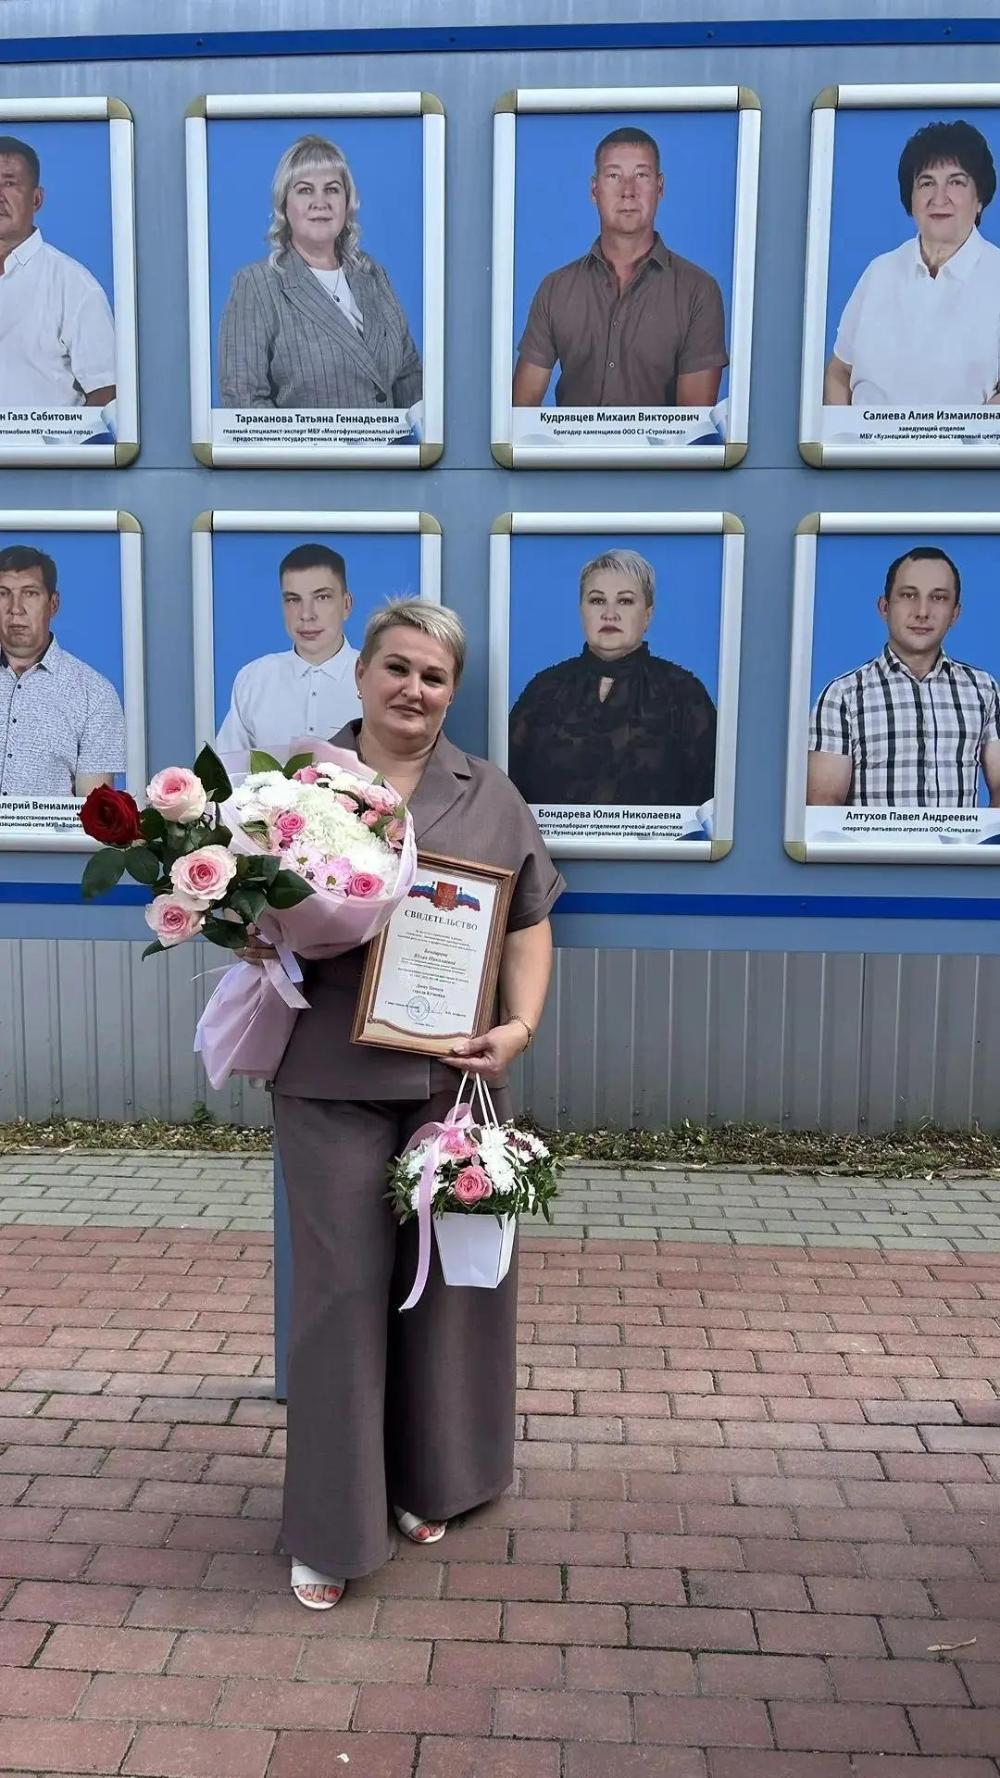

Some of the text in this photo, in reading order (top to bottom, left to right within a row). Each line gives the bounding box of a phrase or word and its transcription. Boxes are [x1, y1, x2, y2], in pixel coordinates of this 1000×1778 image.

[7, 411, 29, 421] Гаяз
[30, 411, 83, 421] Сабитович
[235, 413, 399, 425] Тараканова Татьяна Геннадьевна
[540, 412, 700, 424] Кудрявцев Михаил Викторович
[863, 410, 1000, 421] Салиева Алия Измаиловна
[0, 801, 30, 811] лерий
[538, 809, 682, 820] Бондарева Юлия Николаевна
[845, 811, 978, 822] Алтухов Павел Андреевич
[404, 909, 478, 931] СВИДЕТЕЛЬСТВО
